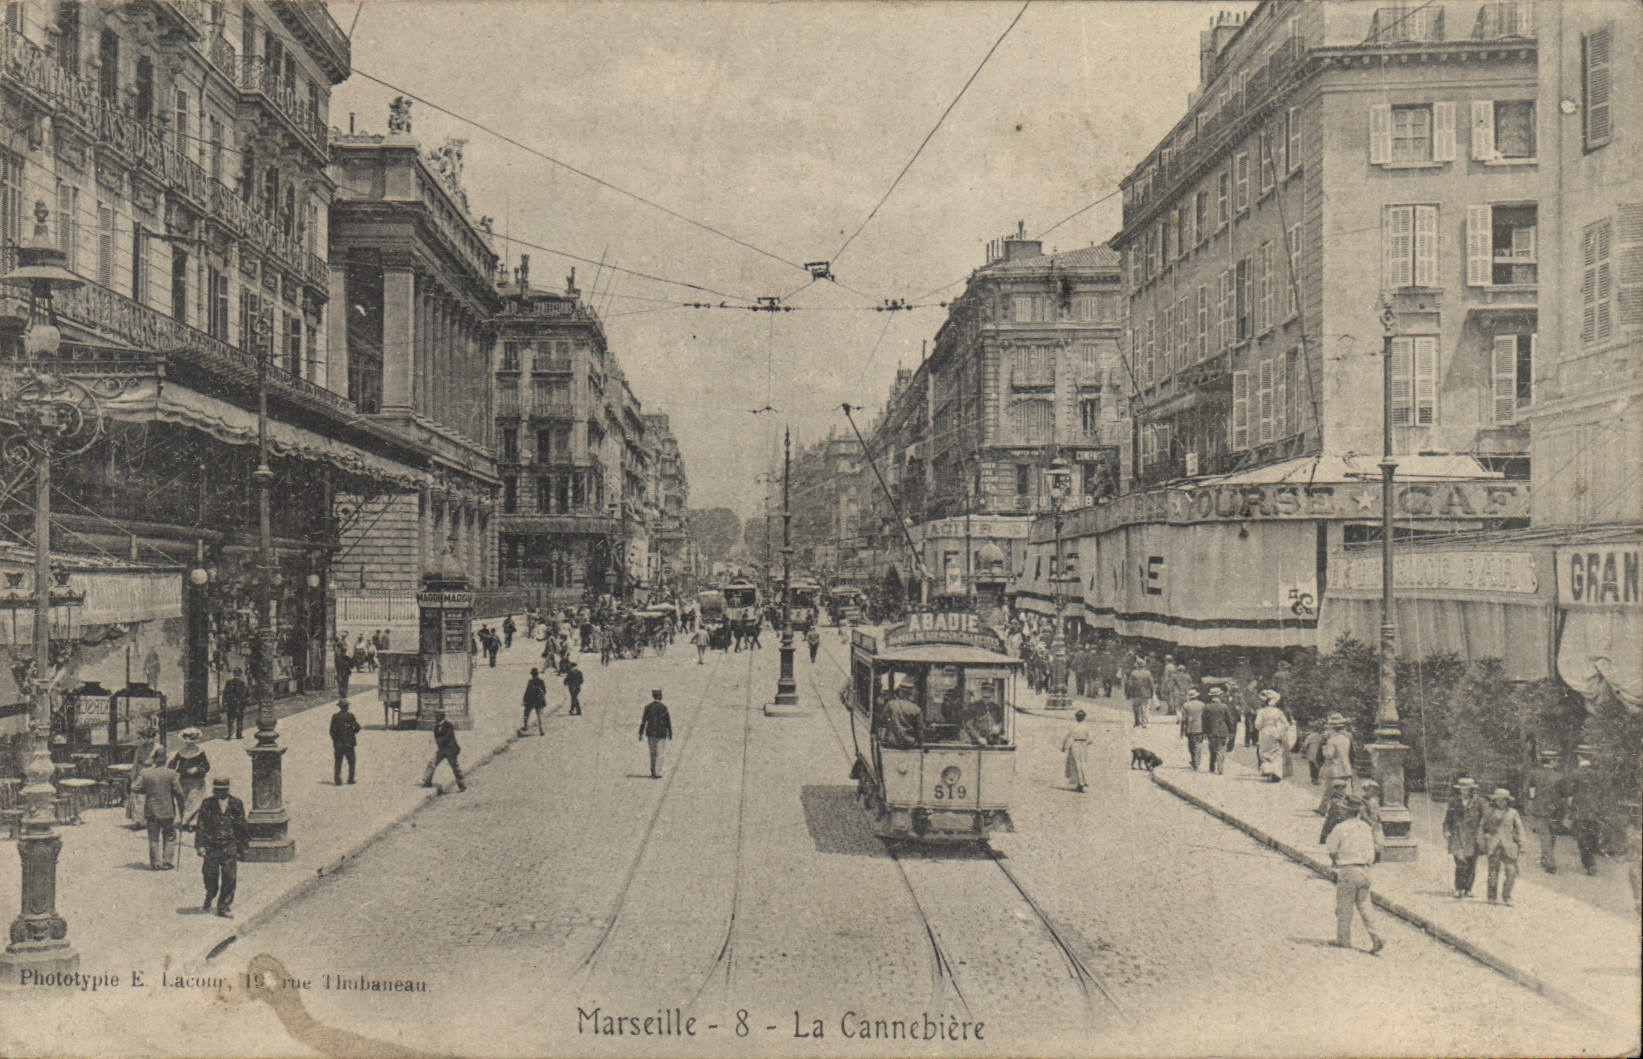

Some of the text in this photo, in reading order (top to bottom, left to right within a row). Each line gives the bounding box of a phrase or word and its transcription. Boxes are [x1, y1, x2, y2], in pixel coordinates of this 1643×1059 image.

[1397, 485, 1531, 515] CAF
[909, 612, 980, 633] ABADIE
[934, 784, 967, 800] 519
